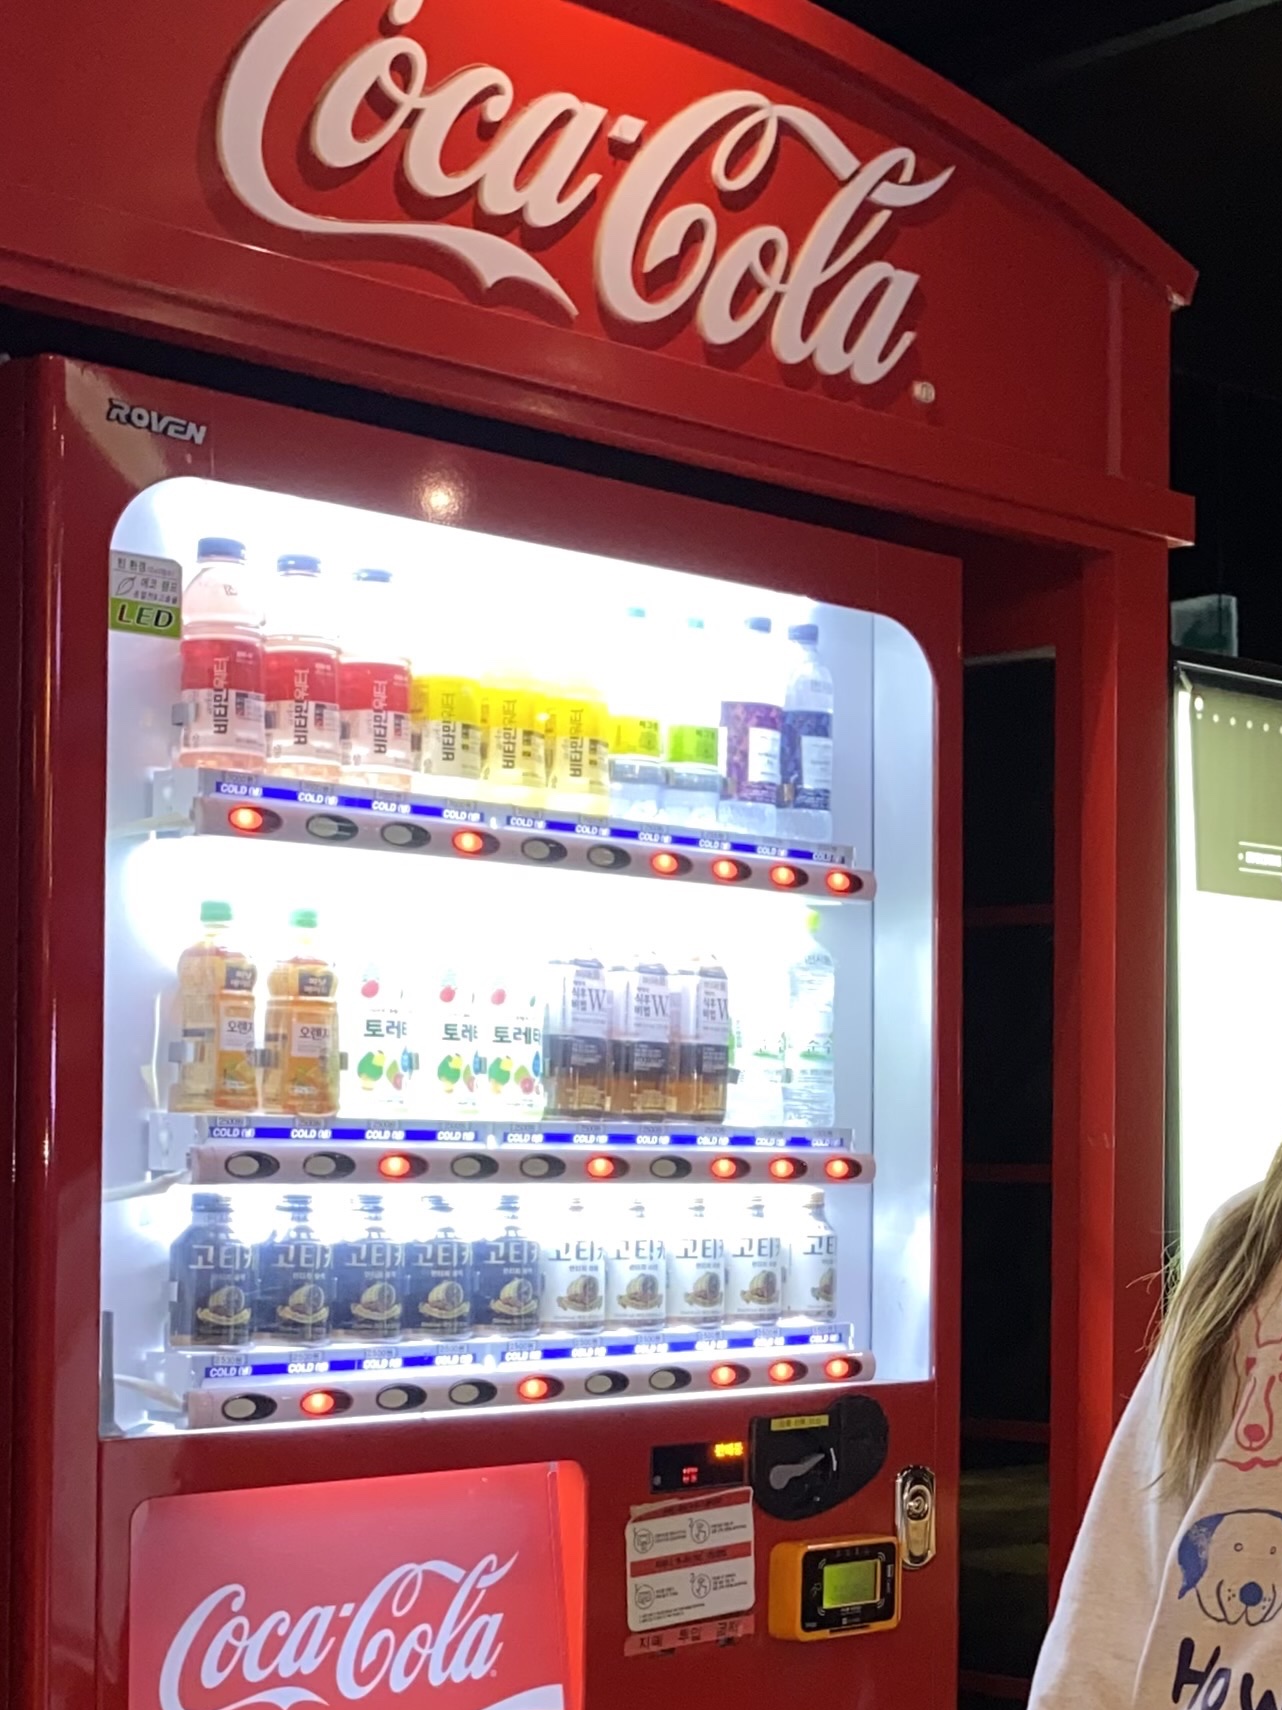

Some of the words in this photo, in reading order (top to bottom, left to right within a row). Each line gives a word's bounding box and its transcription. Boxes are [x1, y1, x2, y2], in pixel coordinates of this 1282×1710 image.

[217, 0, 955, 386] Coca-Cola
[106, 398, 208, 446] ROVEN
[117, 603, 175, 629] LED
[220, 783, 247, 795] COLD
[297, 792, 324, 803] COLD
[371, 800, 397, 812] COLD
[442, 809, 467, 820] COLD
[510, 817, 534, 828] COLD
[575, 825, 598, 836] COLD
[638, 832, 660, 842] COLD
[698, 839, 719, 849] COLD
[213, 1128, 240, 1137] COLD
[290, 1128, 316, 1139] COLD
[365, 1130, 391, 1140] COLD
[437, 1131, 461, 1141] COLD
[209, 1367, 237, 1378] COLD
[287, 1362, 314, 1373] COLD
